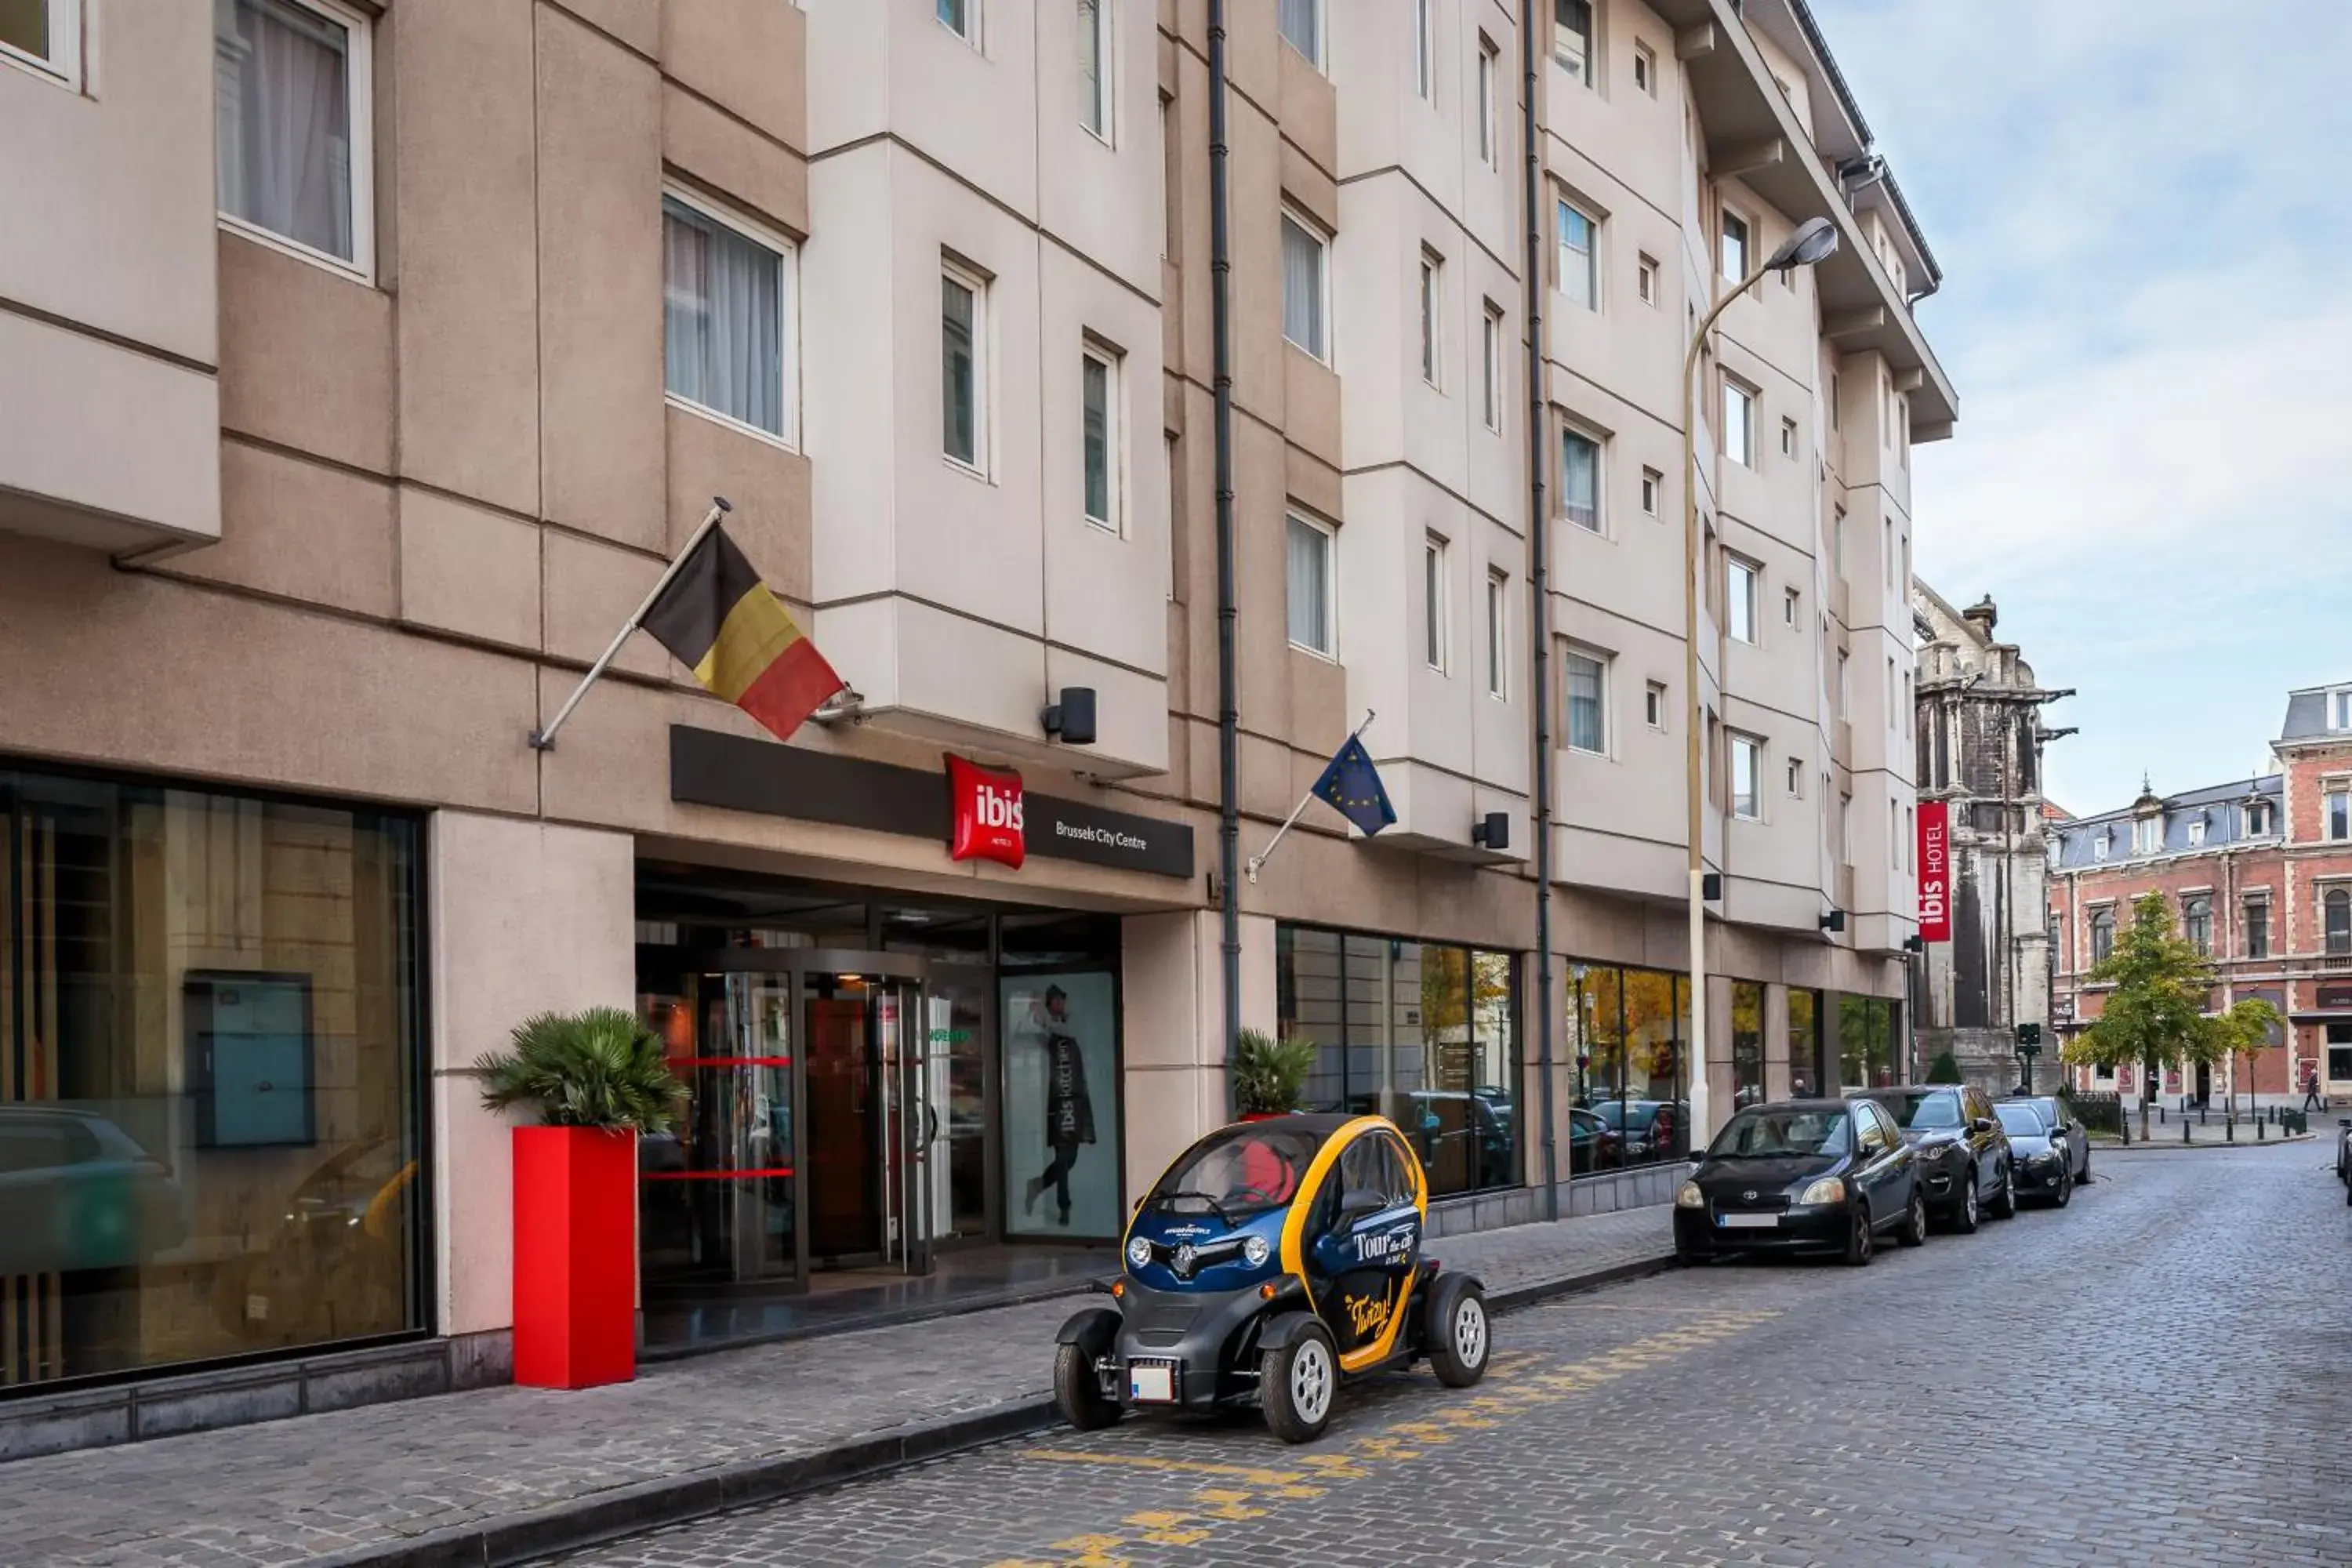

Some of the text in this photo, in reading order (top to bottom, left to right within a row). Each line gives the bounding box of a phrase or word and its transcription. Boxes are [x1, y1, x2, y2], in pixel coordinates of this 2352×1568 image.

[976, 784, 1024, 830] ibis
[1056, 820, 1147, 851] Brussels City Centre
[1919, 822, 1944, 924] ibis HOTEL
[1354, 1232, 1391, 1261] Tour
